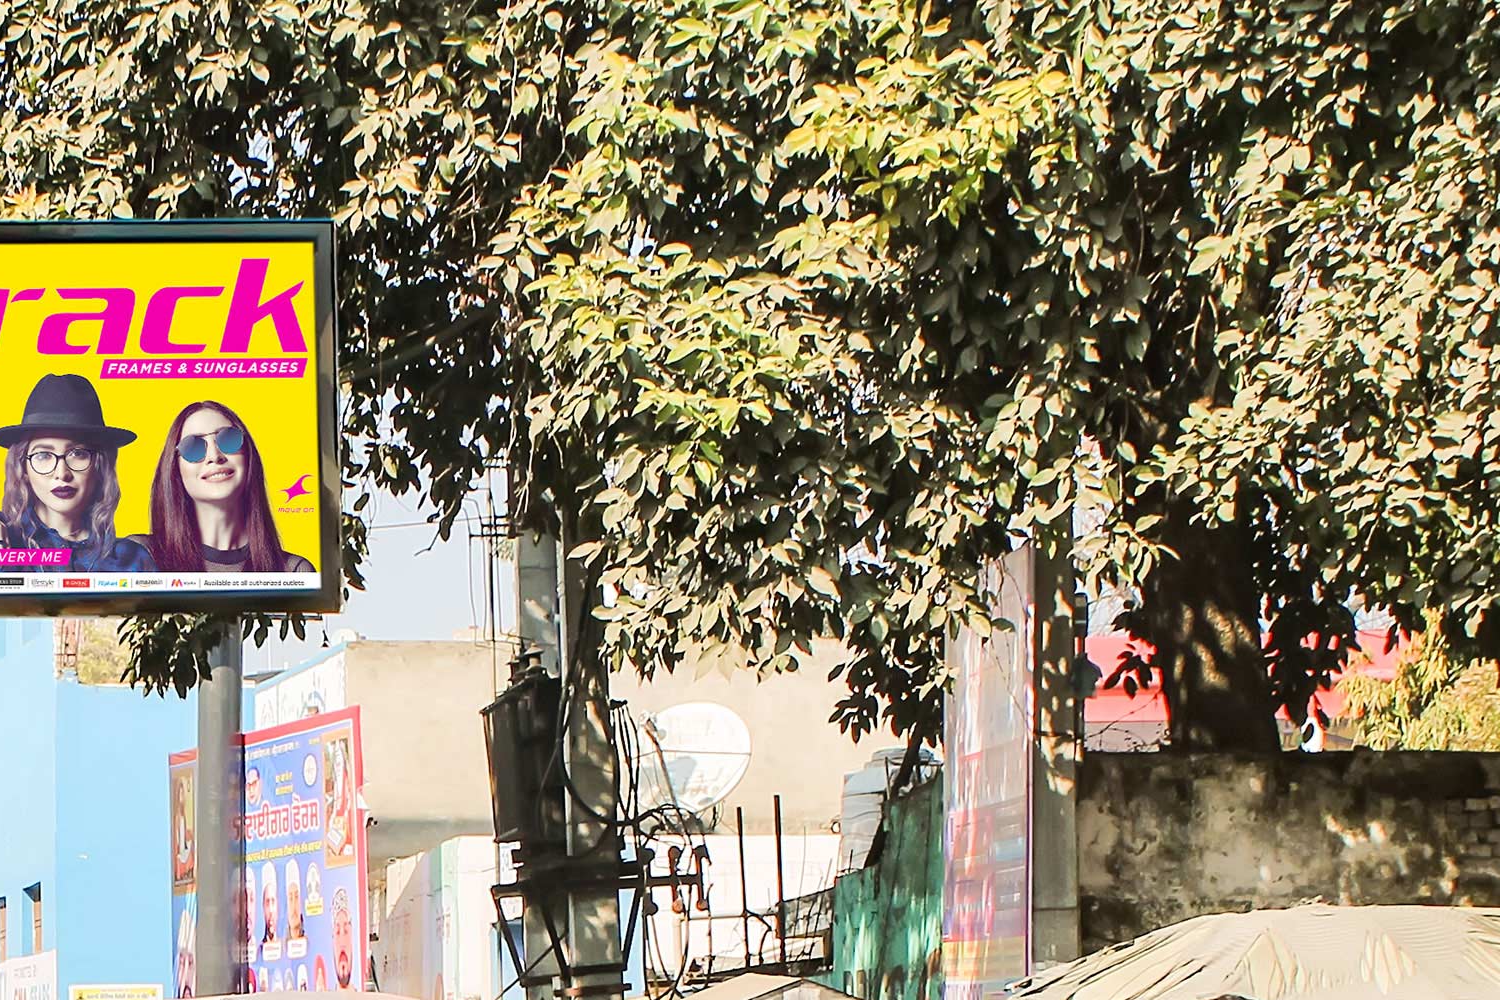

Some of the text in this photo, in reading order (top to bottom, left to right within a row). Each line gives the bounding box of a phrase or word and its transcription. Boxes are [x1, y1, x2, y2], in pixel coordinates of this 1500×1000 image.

[107, 361, 299, 375] FRAMES & SUNGLASSES
[41, 551, 62, 563] ME
